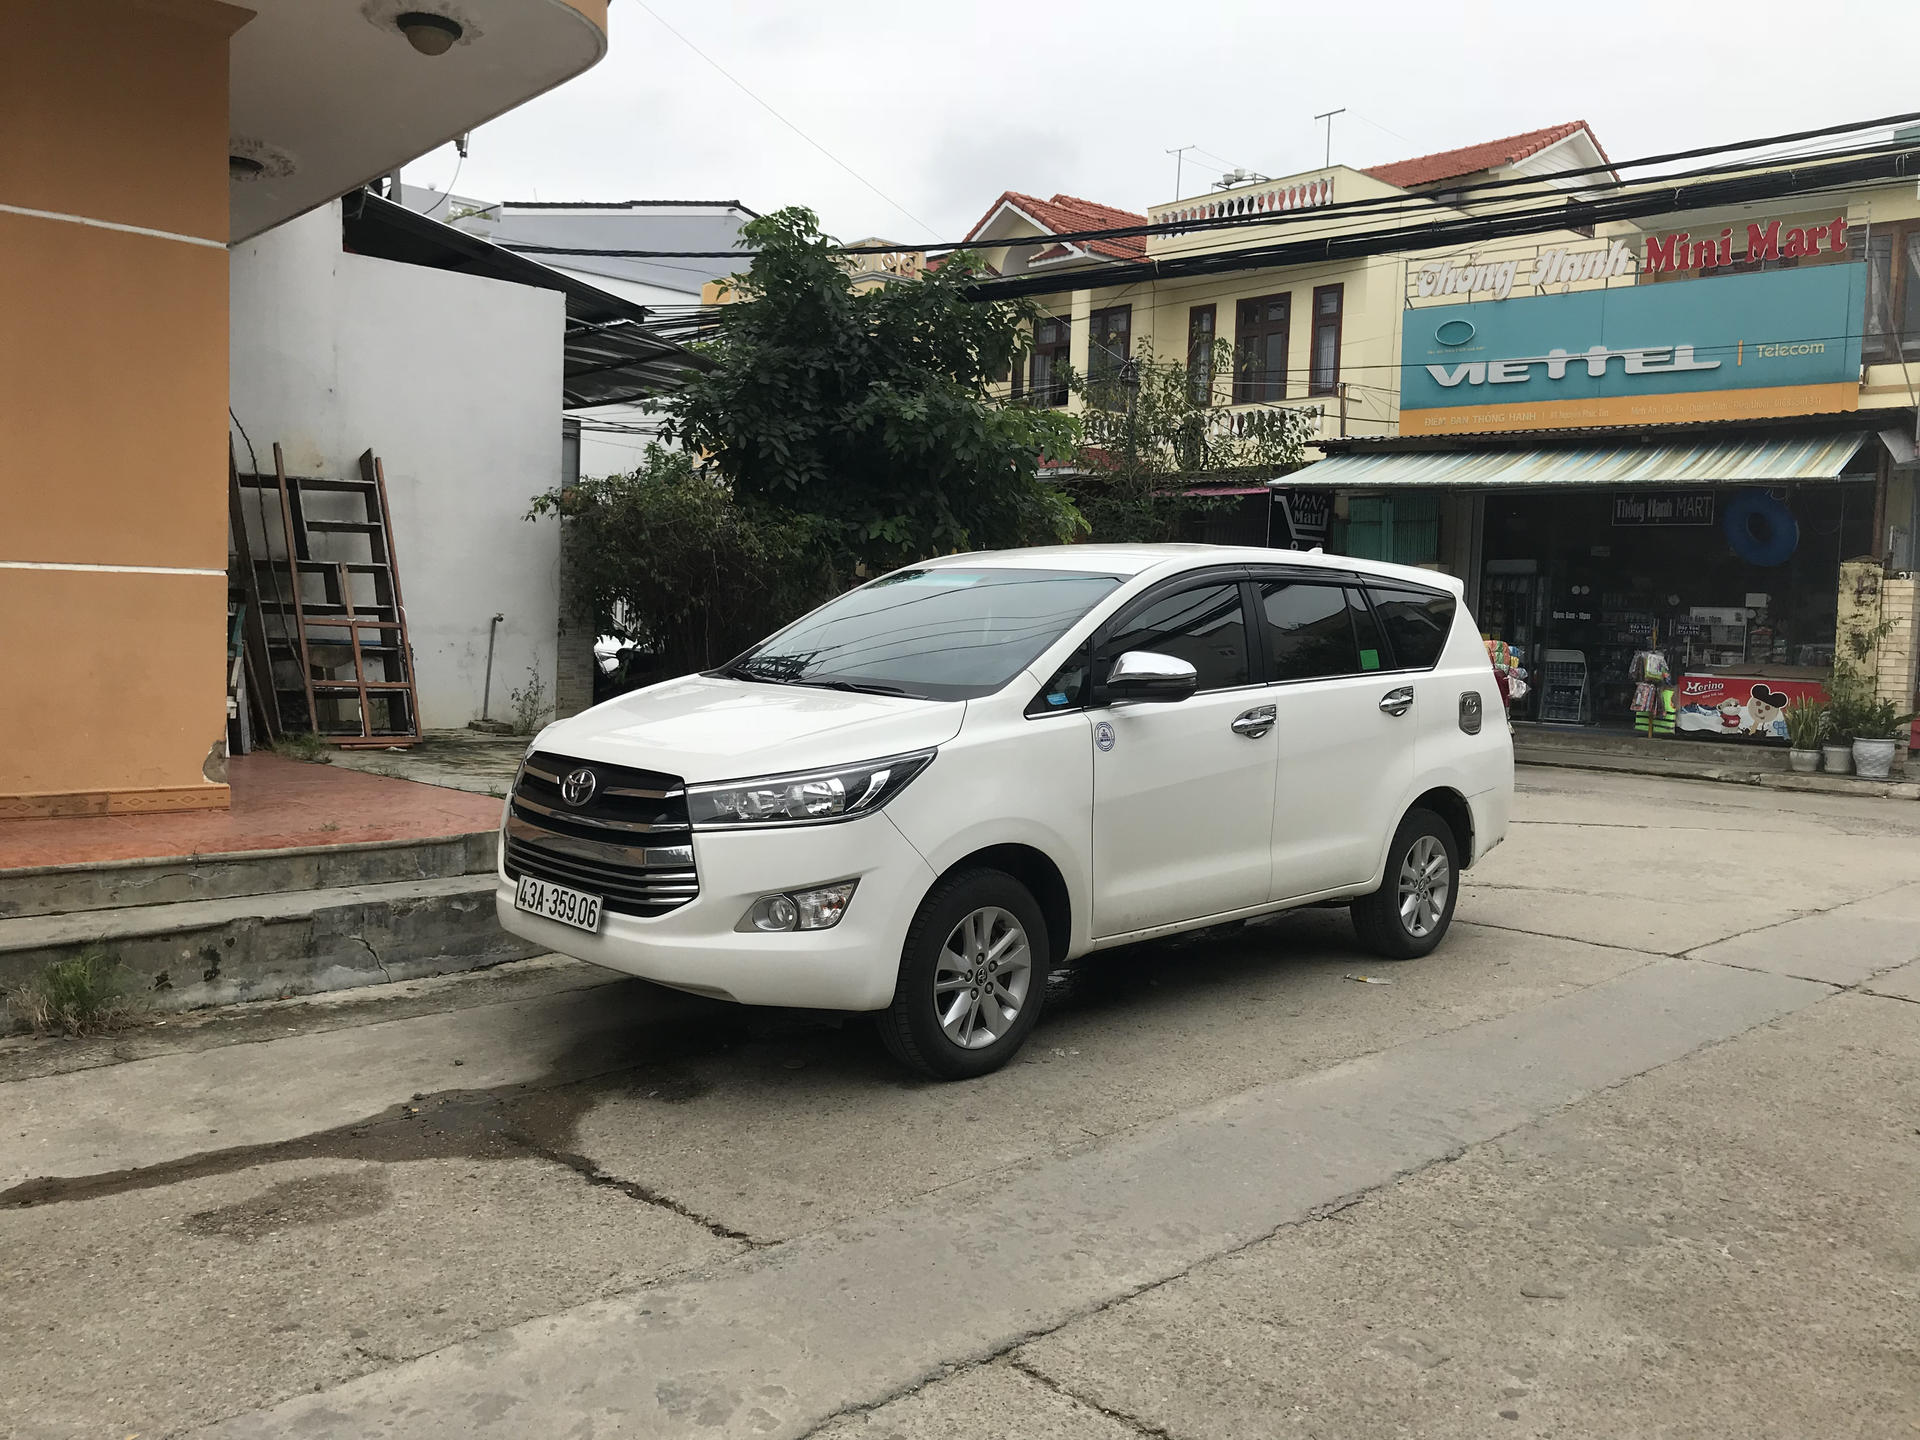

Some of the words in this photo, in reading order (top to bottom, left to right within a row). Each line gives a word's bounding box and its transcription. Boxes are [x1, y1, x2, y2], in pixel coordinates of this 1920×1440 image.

[1643, 227, 1732, 274] Mini
[1746, 216, 1849, 263] Mart
[1756, 341, 1825, 358] Telecom
[1676, 496, 1712, 518] MART
[1294, 510, 1322, 524] Mart
[1685, 681, 1724, 693] Merino
[518, 878, 598, 928] 43A-359.06
